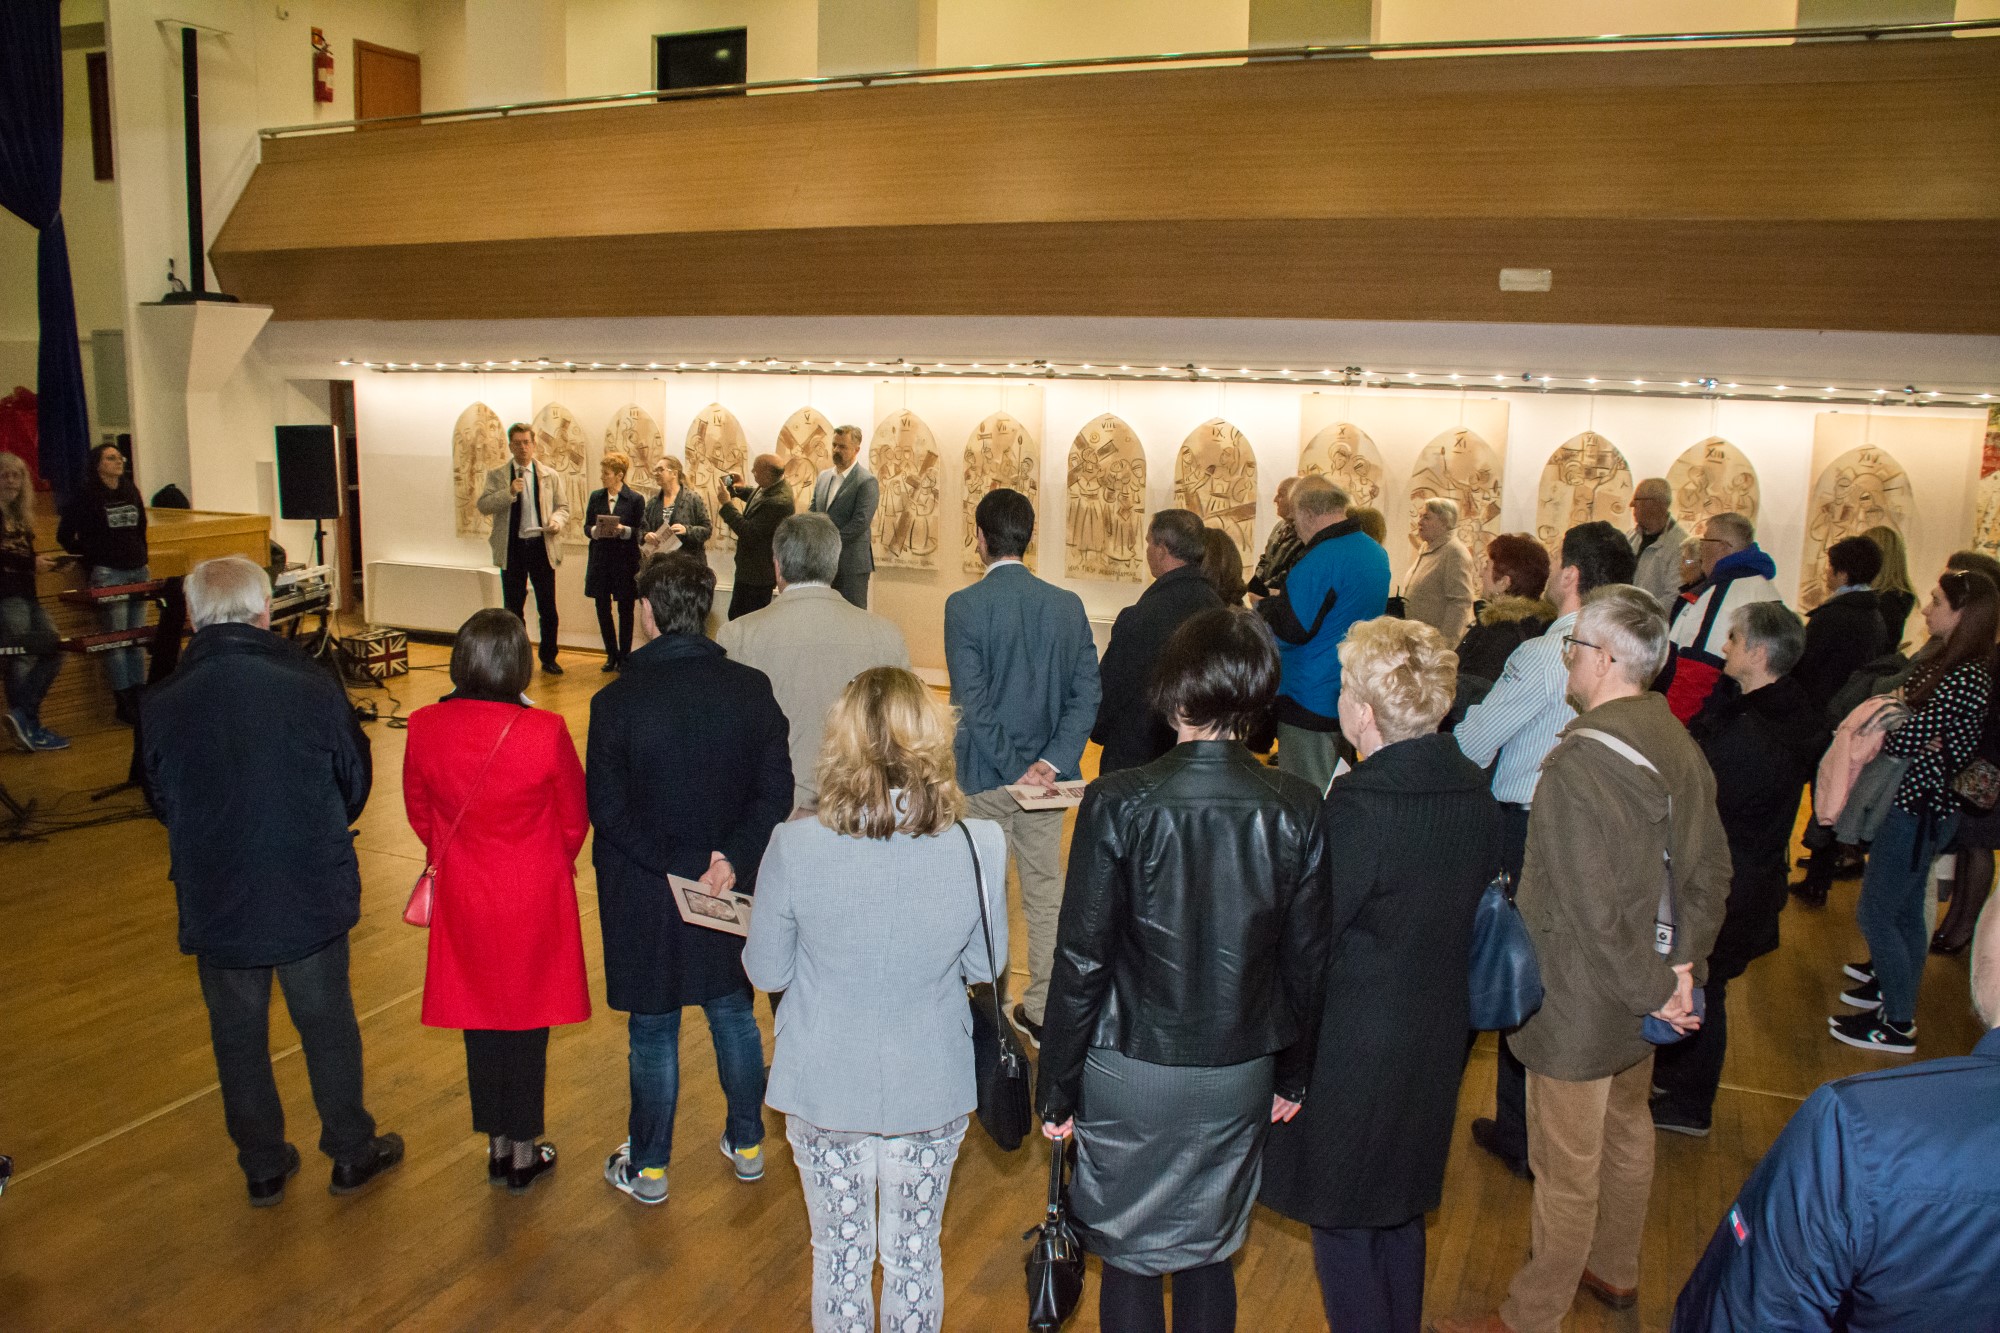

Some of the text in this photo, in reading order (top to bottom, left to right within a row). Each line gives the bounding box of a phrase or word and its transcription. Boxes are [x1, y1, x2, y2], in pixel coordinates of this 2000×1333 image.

[713, 412, 722, 425] IV
[900, 416, 911, 429] VI
[996, 421, 1008, 433] VII
[1454, 435, 1467, 450] XI
